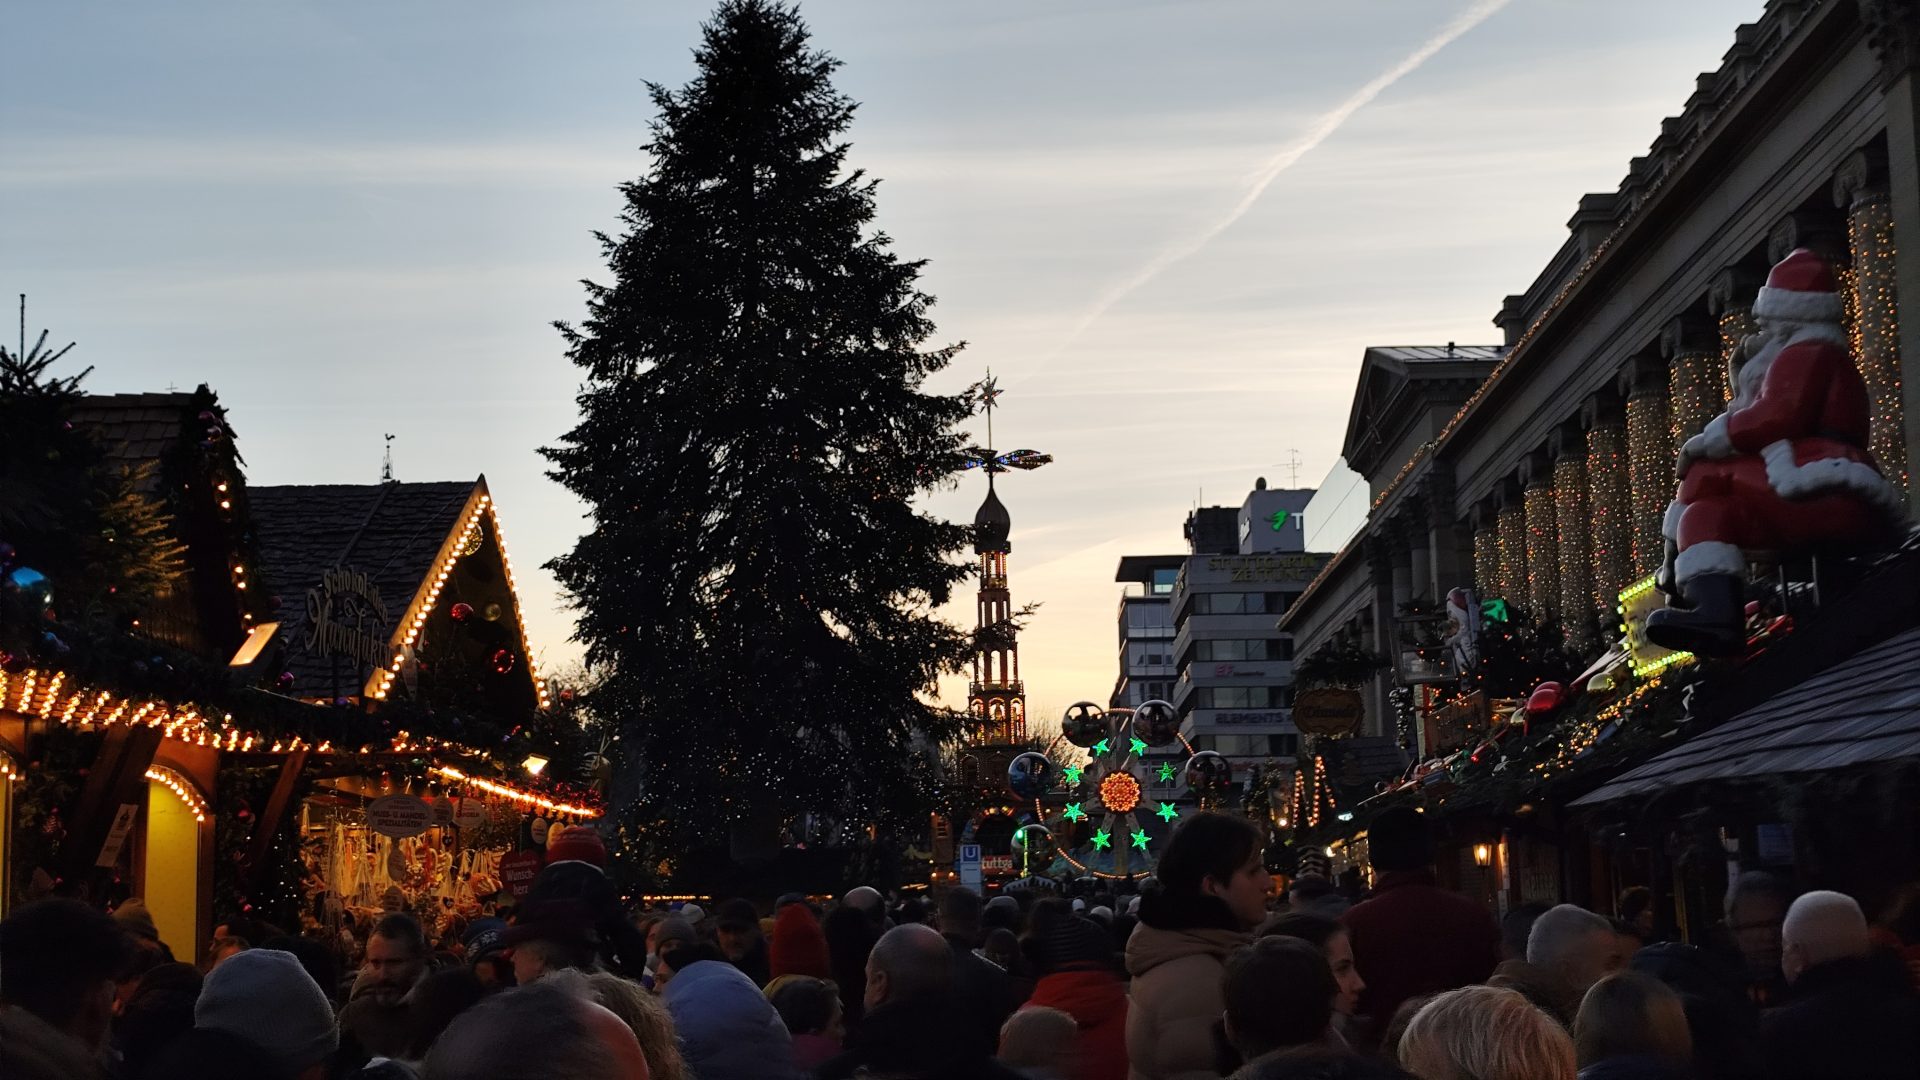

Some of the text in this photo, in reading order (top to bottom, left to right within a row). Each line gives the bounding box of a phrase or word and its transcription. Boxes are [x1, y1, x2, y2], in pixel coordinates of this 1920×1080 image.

[1208, 556, 1321, 569] STUTTGARTE
[1216, 713, 1283, 723] ELEMENTS
[965, 847, 976, 859] U
[981, 857, 1013, 871] tuttga
[512, 884, 529, 896] herz
